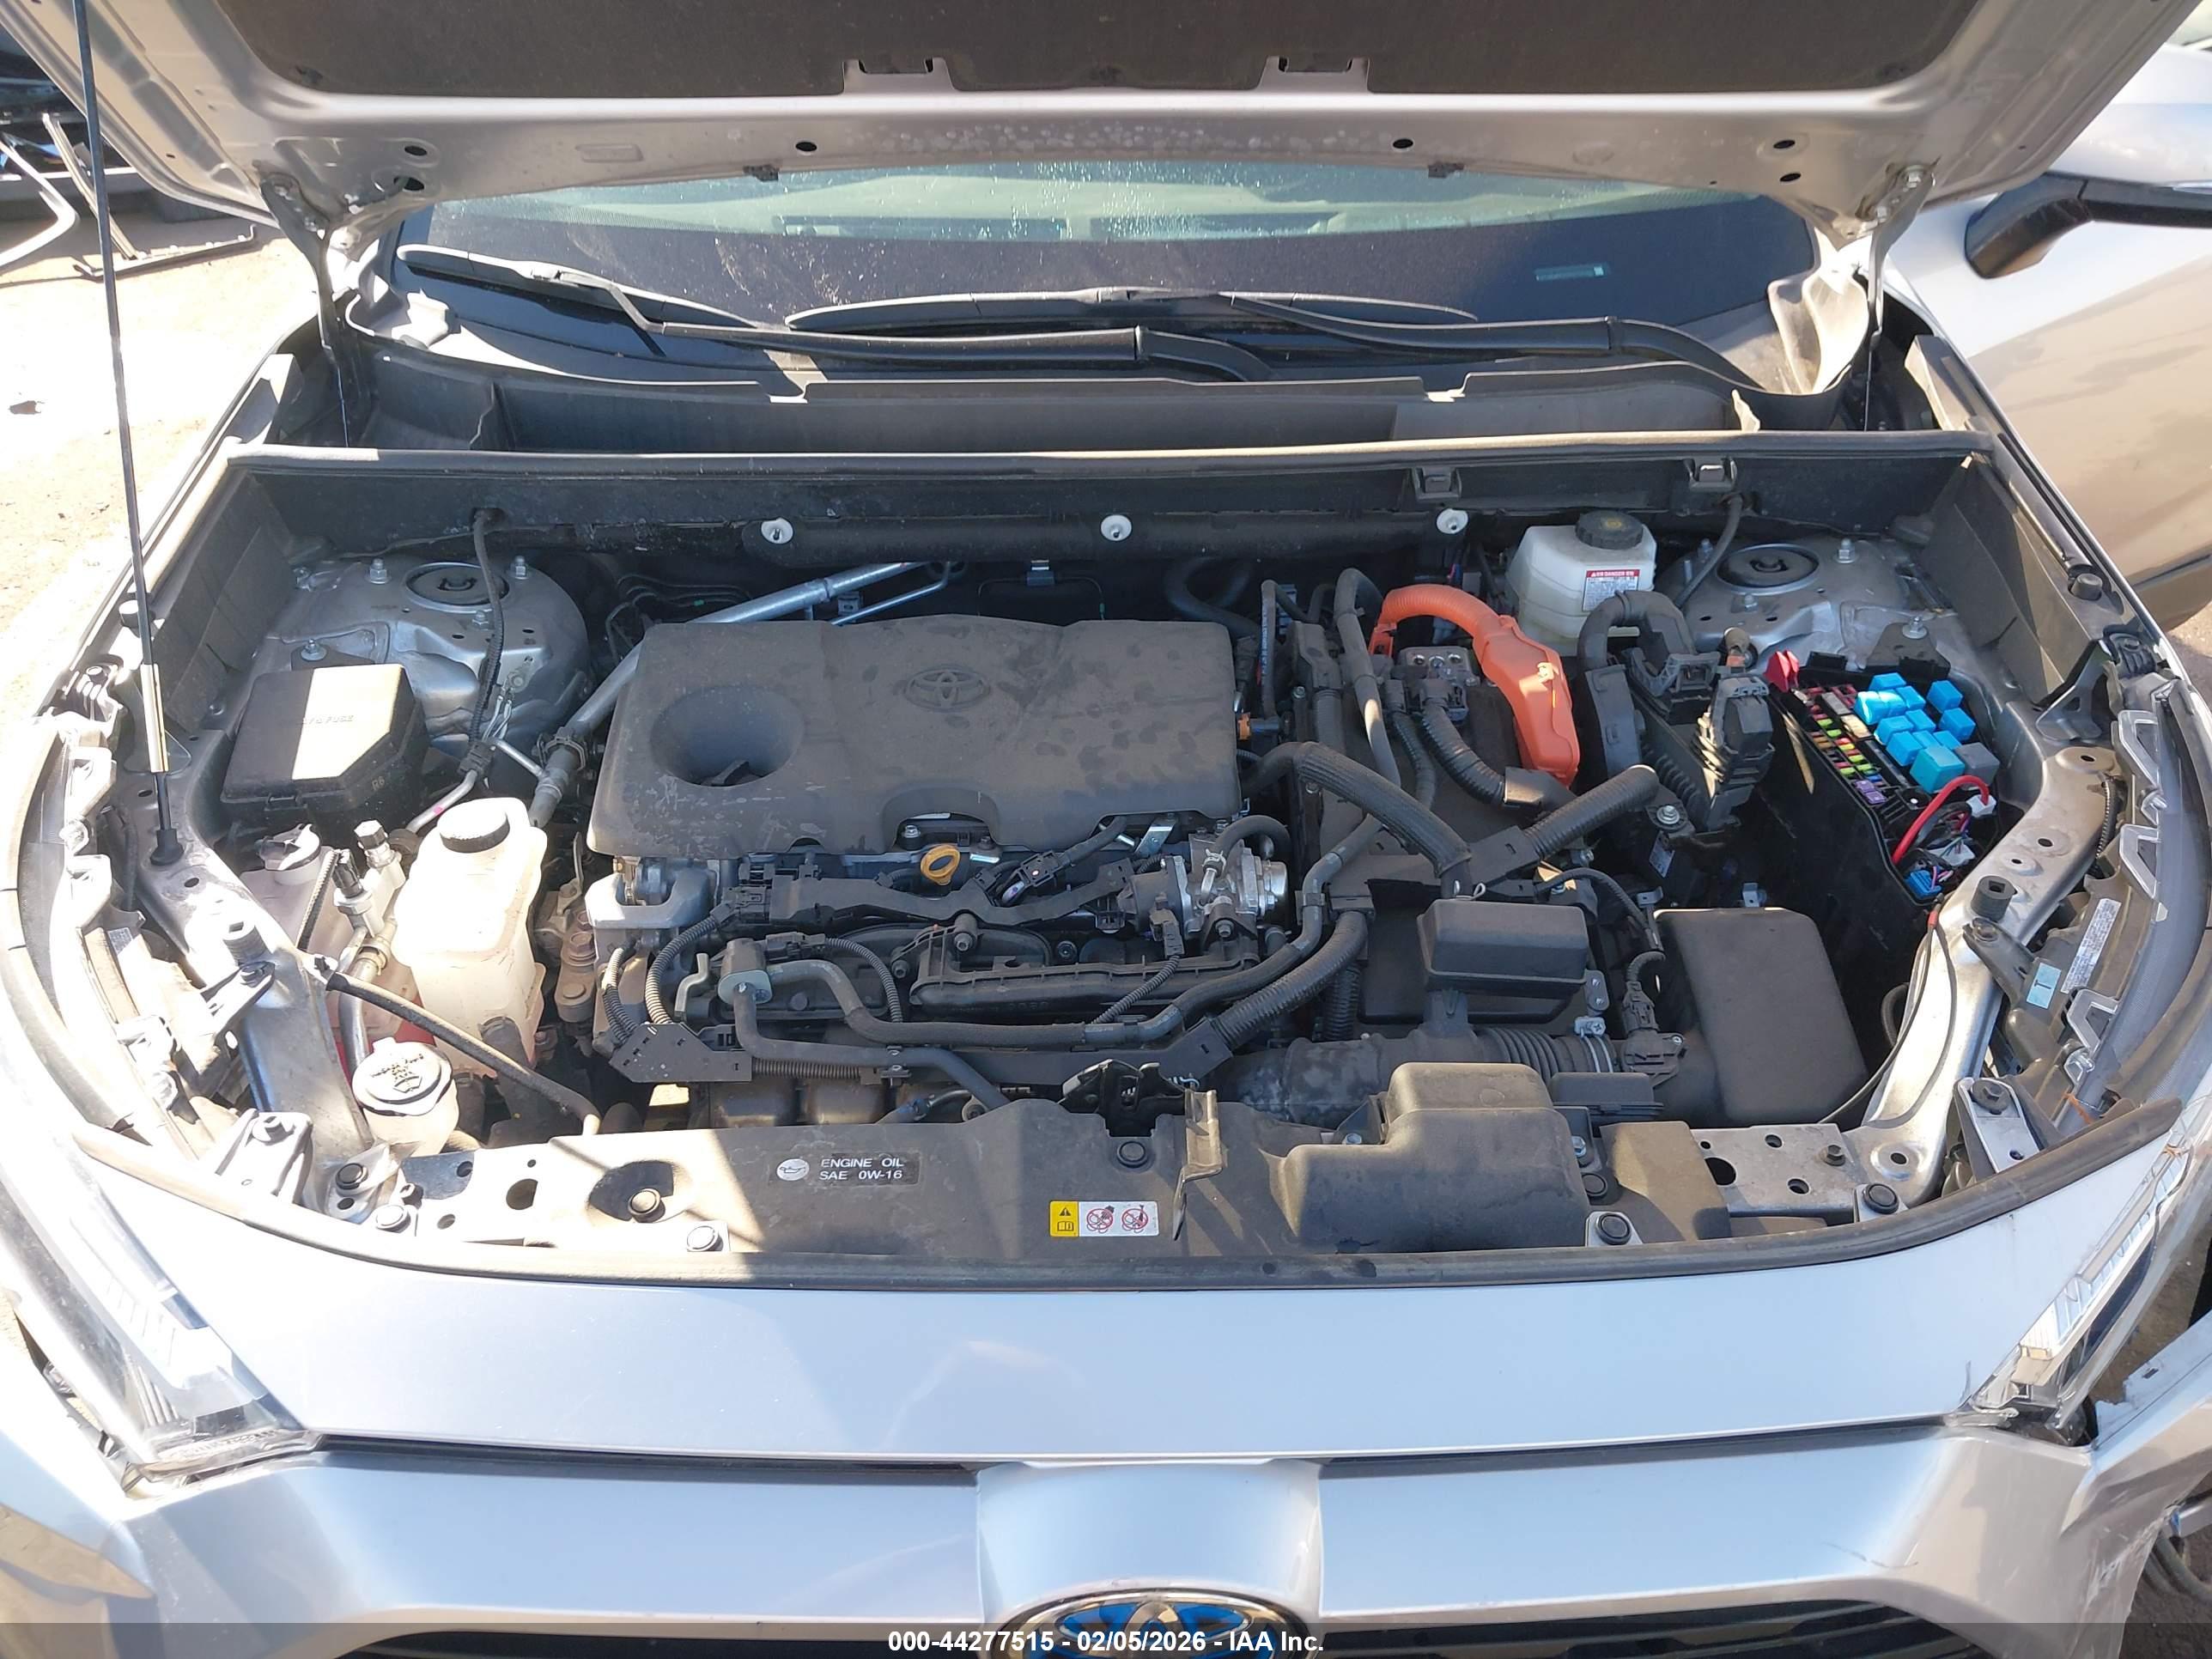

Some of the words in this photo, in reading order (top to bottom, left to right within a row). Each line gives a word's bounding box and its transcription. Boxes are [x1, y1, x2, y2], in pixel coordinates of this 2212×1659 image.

[821, 1158, 872, 1168] ENGINE
[882, 1158, 904, 1168] OIL
[819, 1170, 848, 1181] SAE
[859, 1170, 902, 1180] 0W-16
